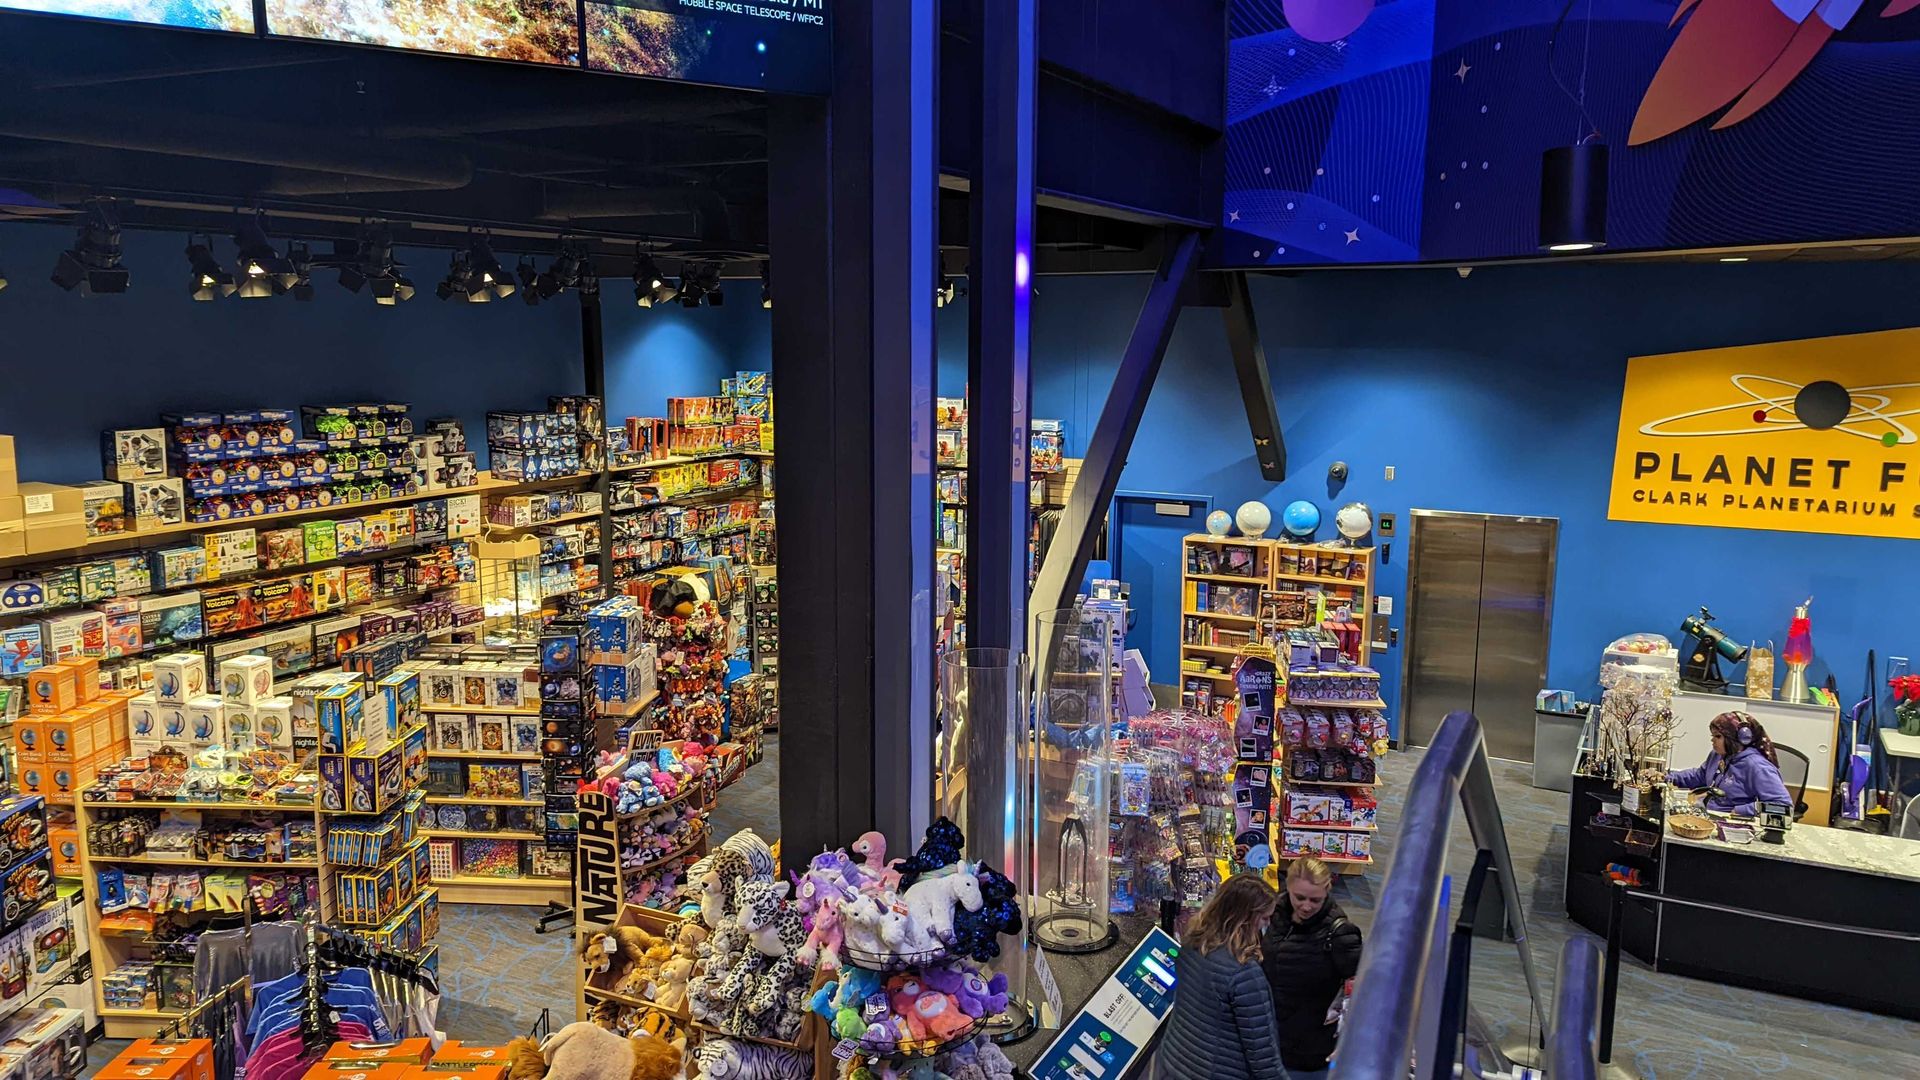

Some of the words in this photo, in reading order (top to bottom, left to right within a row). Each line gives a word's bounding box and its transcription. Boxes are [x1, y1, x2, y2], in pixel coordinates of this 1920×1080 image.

[679, 0, 714, 10] HUBBLE
[716, 1, 743, 14] SPACE
[744, 5, 791, 21] TELESCOPE
[797, 13, 824, 26] WFPC2
[1634, 452, 1850, 490] PLANET
[1632, 489, 1708, 507] CLARK
[1722, 494, 1896, 518] PLANETARIUM
[206, 599, 235, 608] Volcano
[263, 587, 289, 597] Volcano
[578, 791, 618, 926] NATURE
[1103, 1003, 1117, 1018] BLAST
